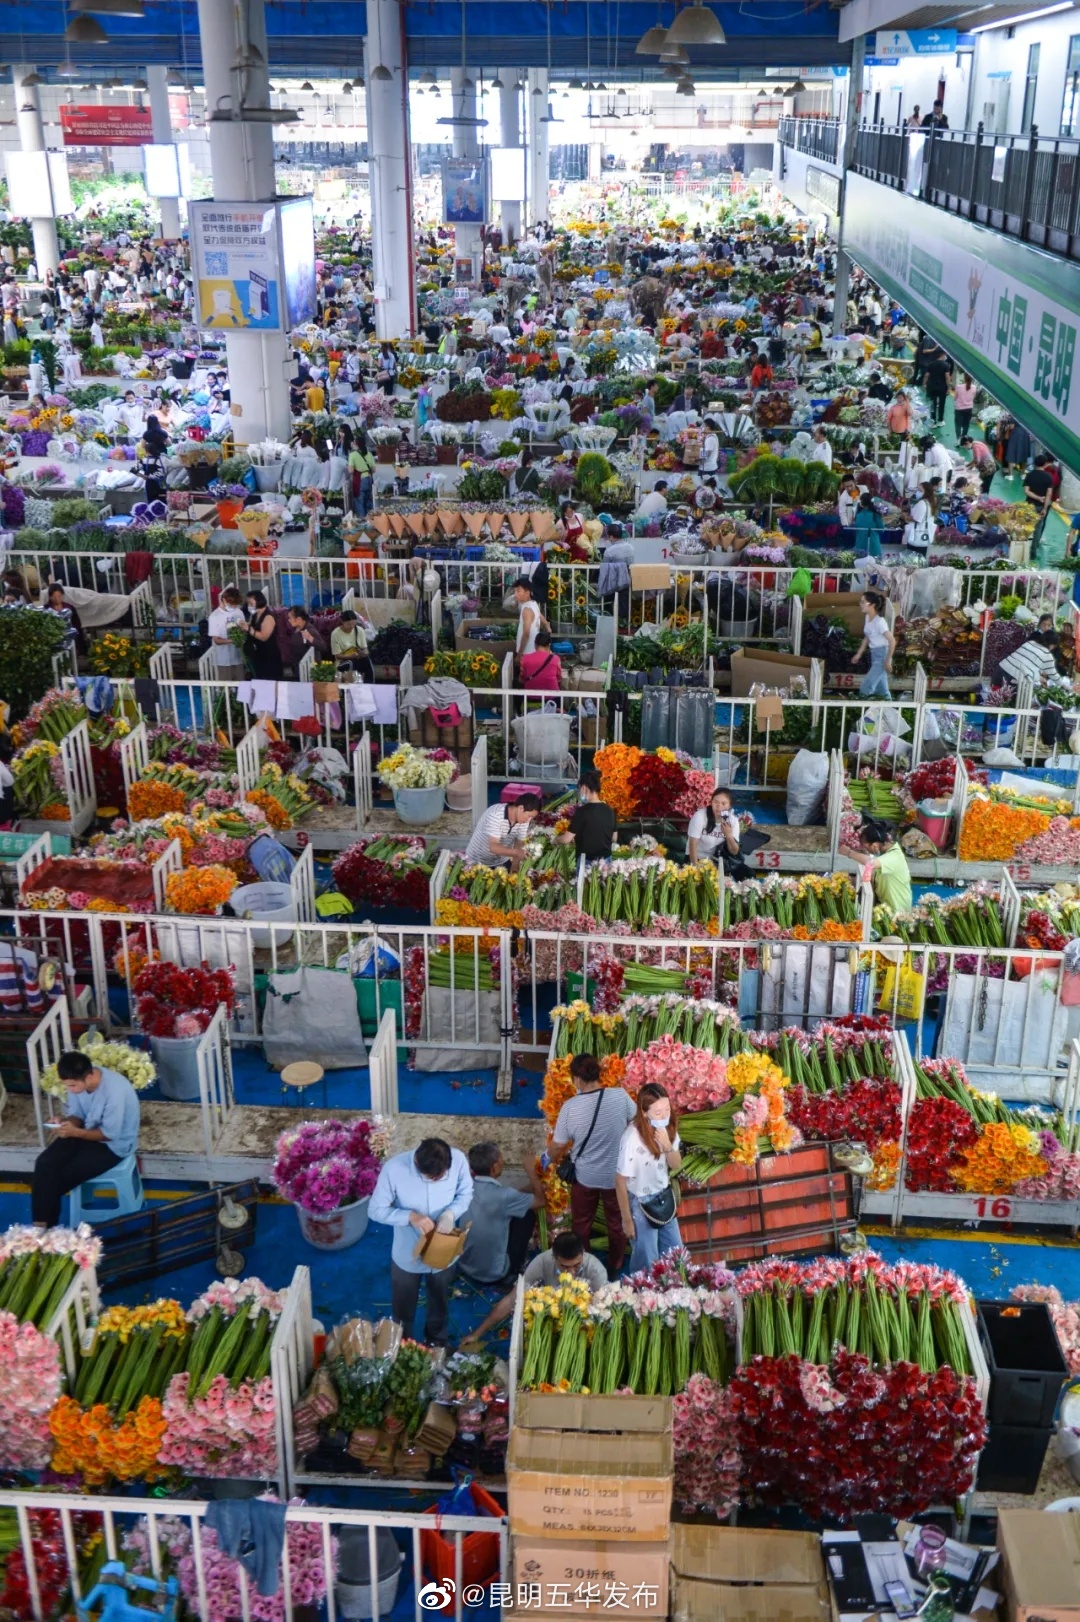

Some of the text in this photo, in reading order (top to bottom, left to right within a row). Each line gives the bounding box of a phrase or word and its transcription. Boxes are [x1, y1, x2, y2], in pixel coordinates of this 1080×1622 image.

[755, 851, 780, 867] 13
[973, 1197, 1011, 1219] 16
[544, 1487, 571, 1497] ITEM
